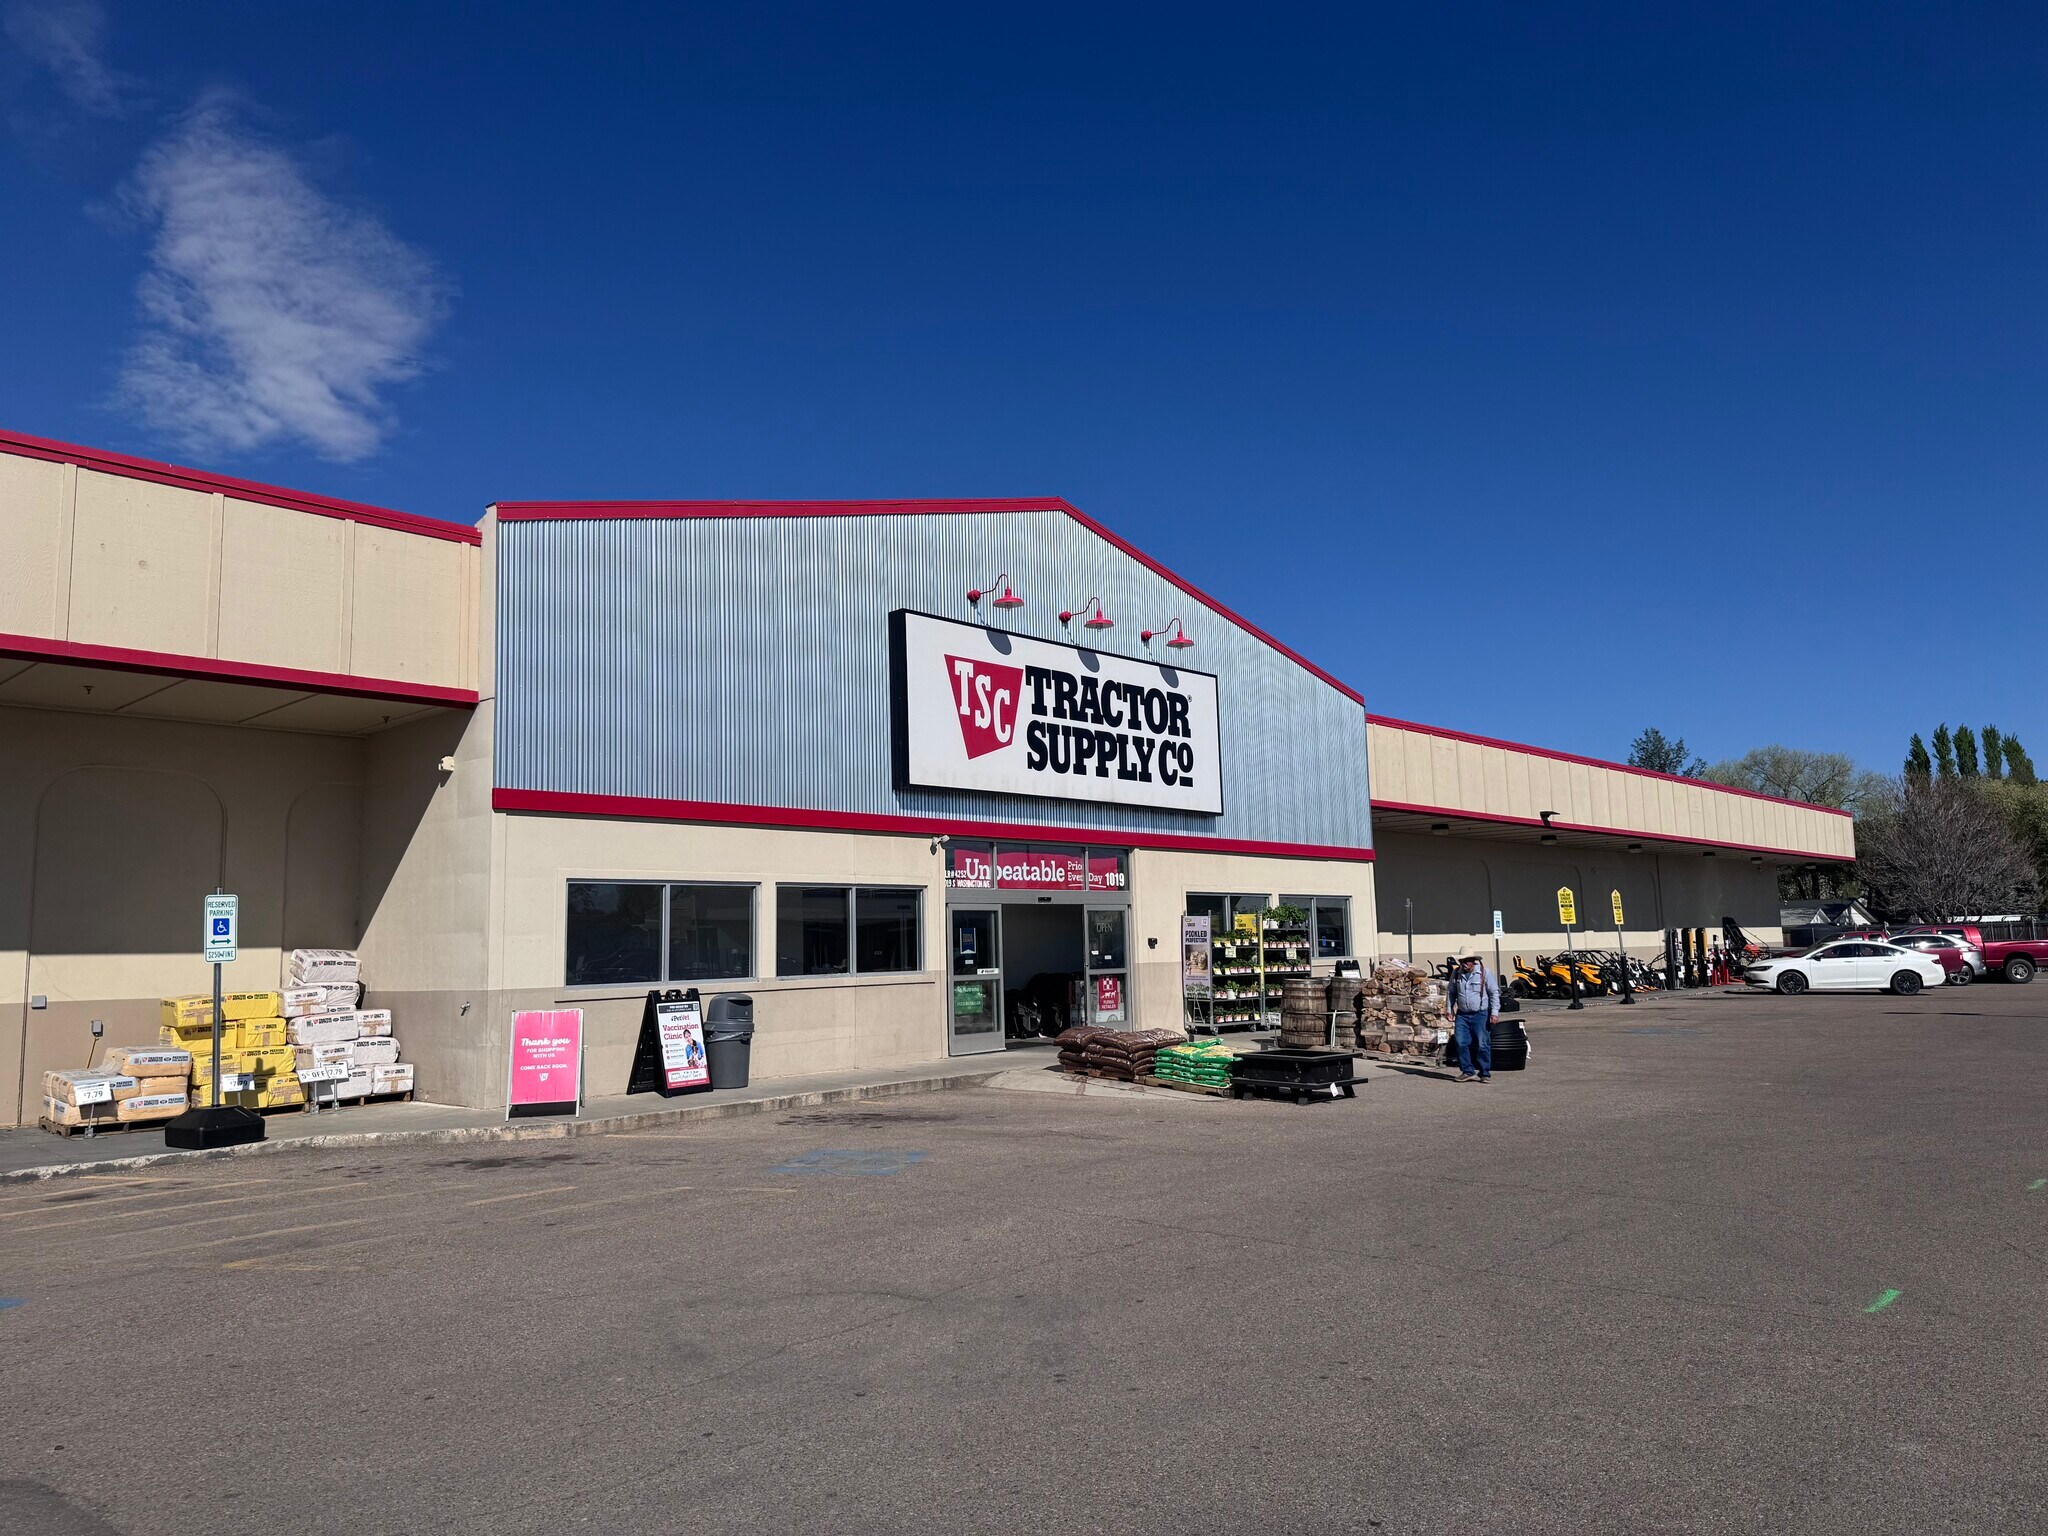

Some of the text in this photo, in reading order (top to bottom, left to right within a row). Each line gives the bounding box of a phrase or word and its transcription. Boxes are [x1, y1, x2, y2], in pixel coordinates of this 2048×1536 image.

[955, 660, 1011, 743] TSC
[1025, 665, 1191, 738] TRACTOR
[1027, 720, 1155, 783] SUPPLY
[1105, 872, 1125, 886] 1019
[521, 1038, 571, 1046] Thank you
[663, 1023, 700, 1032] Vaccination
